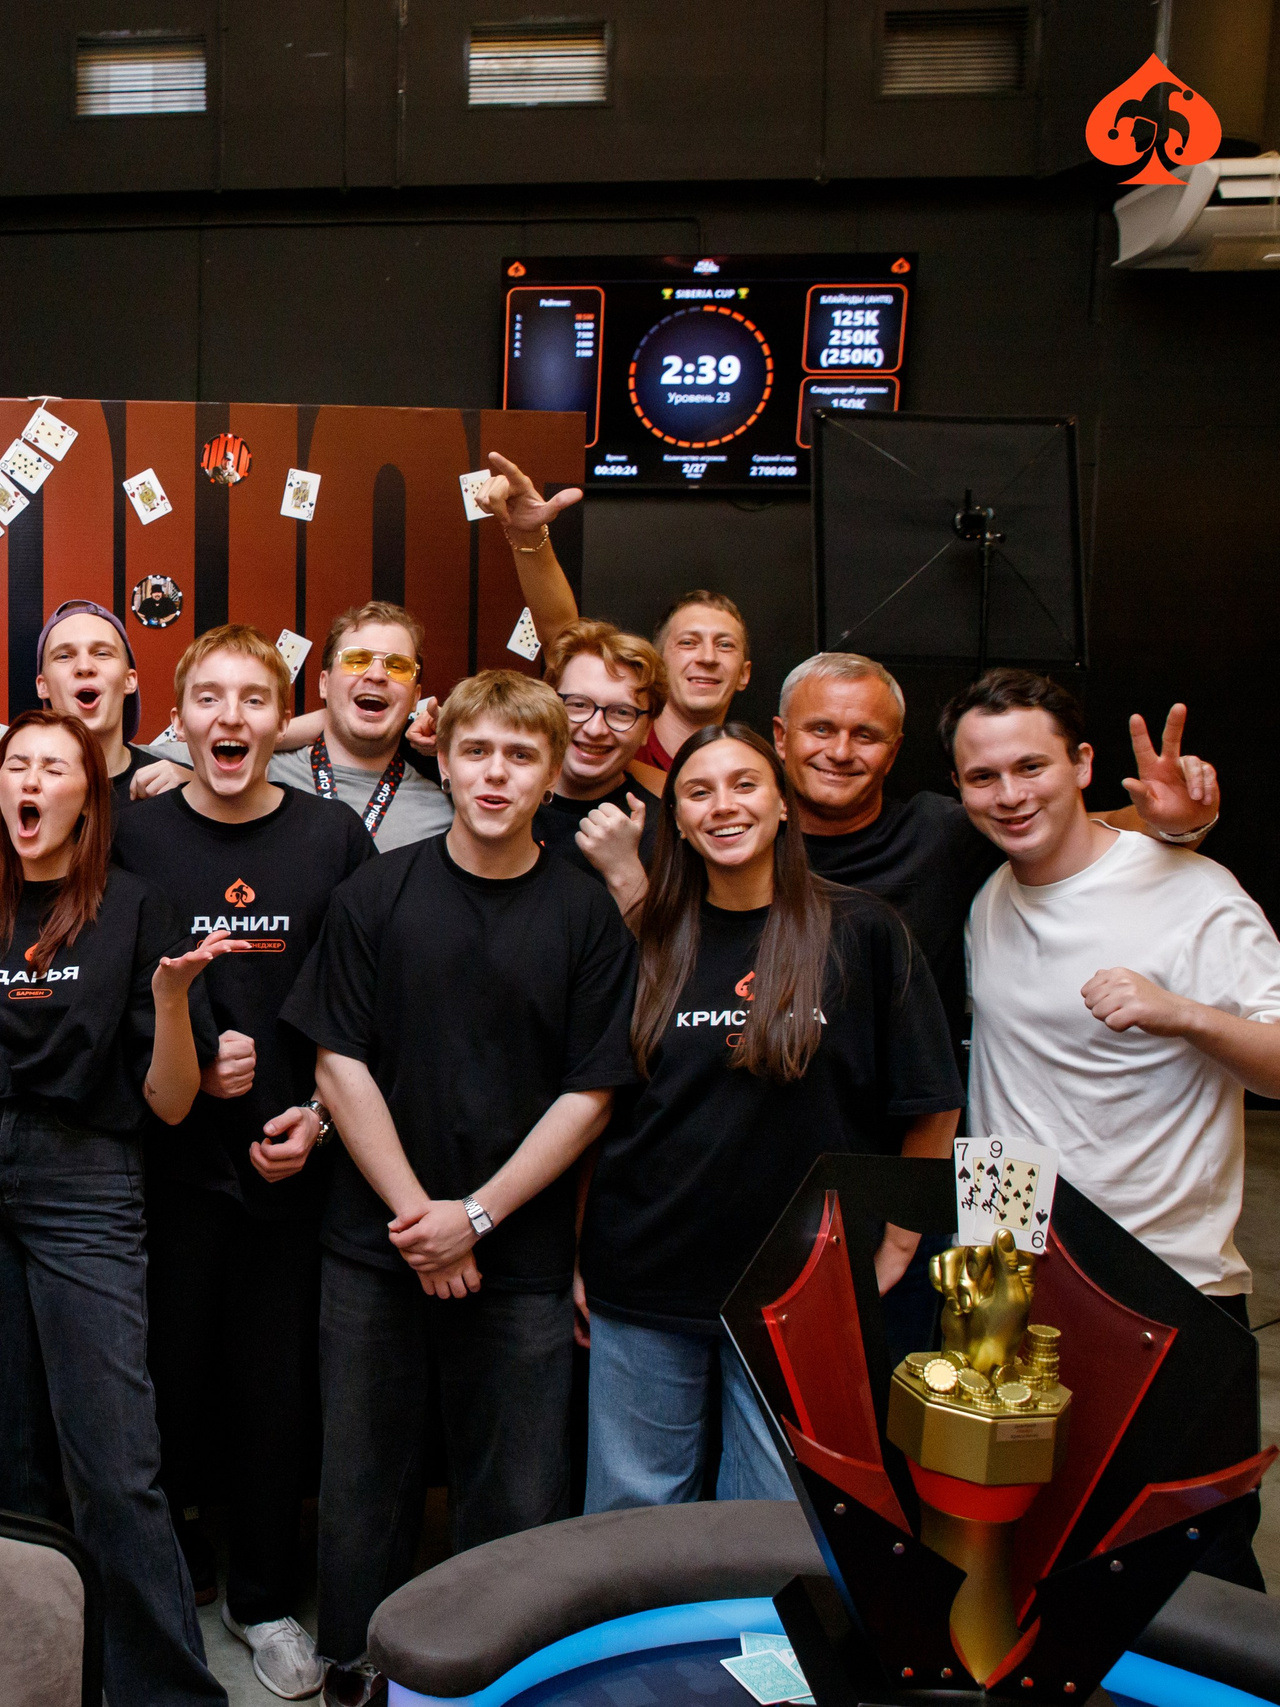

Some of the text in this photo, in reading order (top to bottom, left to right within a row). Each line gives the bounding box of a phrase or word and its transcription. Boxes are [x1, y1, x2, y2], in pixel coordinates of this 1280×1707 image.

[675, 288, 736, 299] SIBERIA CUP
[831, 310, 880, 326] 125K
[828, 329, 880, 346] 250K
[820, 348, 884, 367] (250K)
[661, 355, 741, 385] 2:39
[667, 391, 731, 405] Уровень 23
[682, 463, 708, 474] 2/27
[318, 769, 330, 790] CUP
[365, 783, 391, 832] BERIA CUP
[191, 916, 290, 934] ДАНИЛ
[956, 1143, 969, 1161] 7
[990, 1140, 1003, 1158] 9
